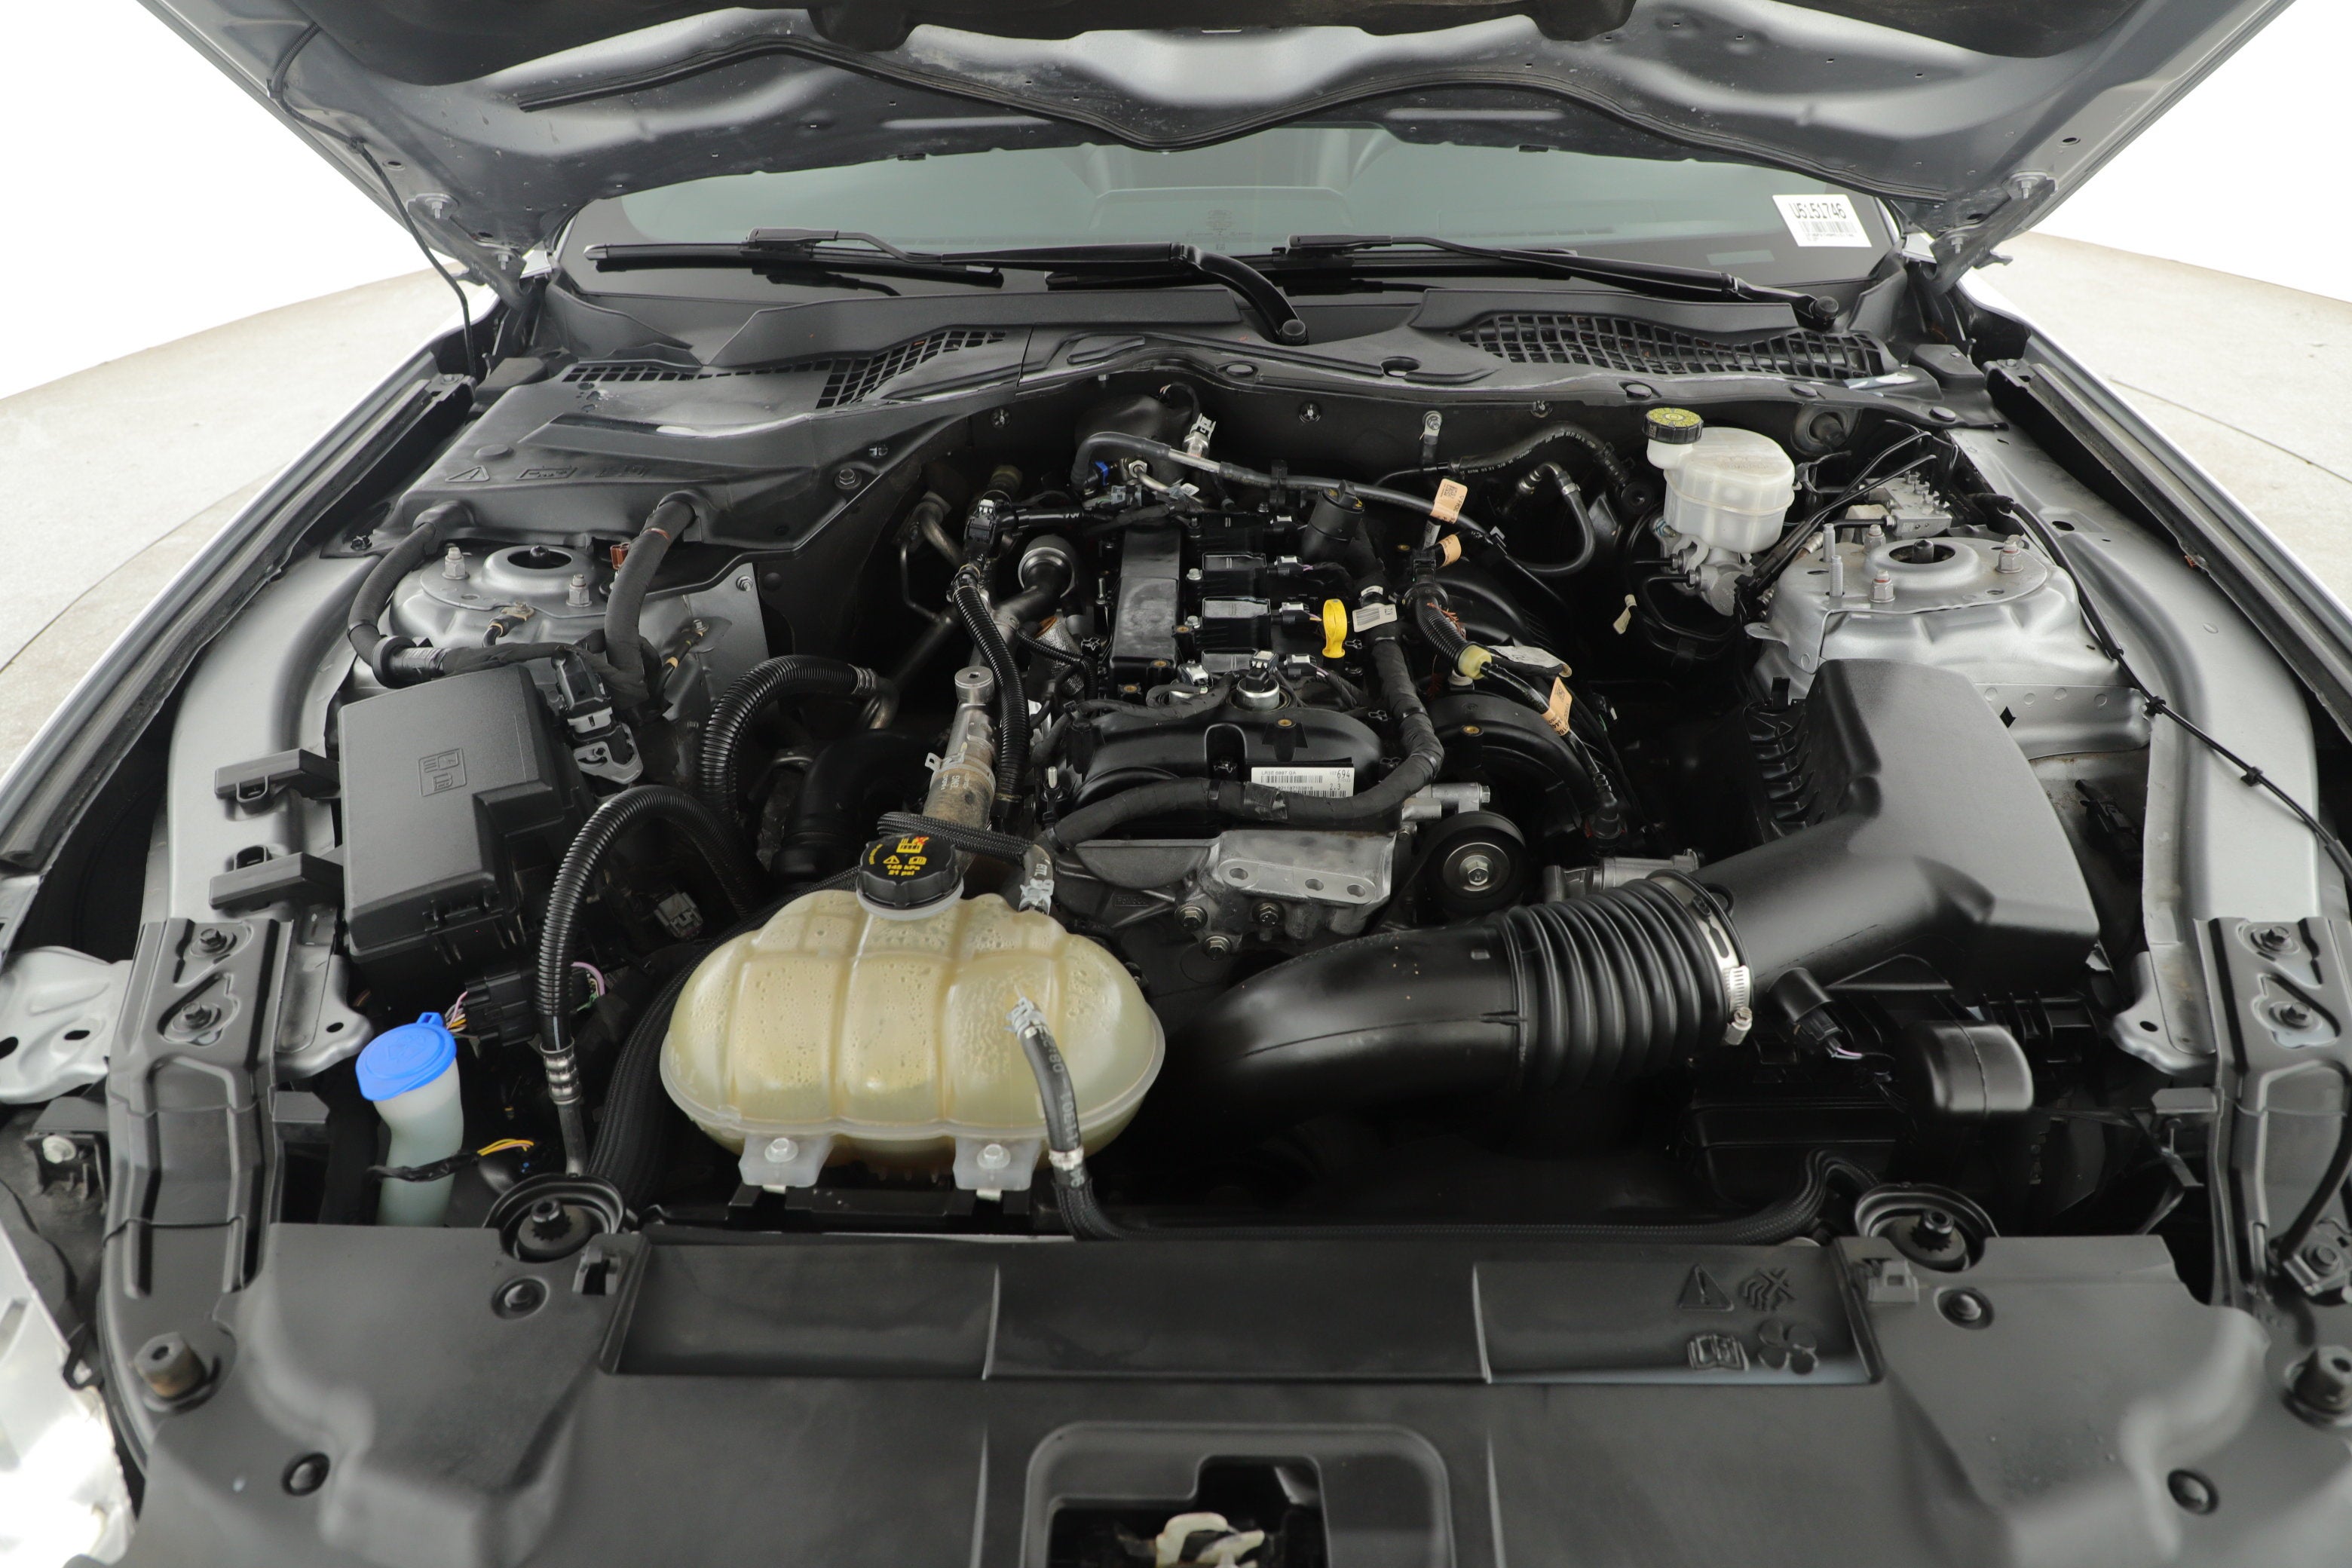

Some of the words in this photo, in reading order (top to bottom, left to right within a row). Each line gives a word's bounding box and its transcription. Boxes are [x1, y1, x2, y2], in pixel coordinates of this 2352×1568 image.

[1789, 202, 1847, 219] U5151746
[1337, 769, 1350, 779] 694
[1329, 782, 1341, 791] 2.3
